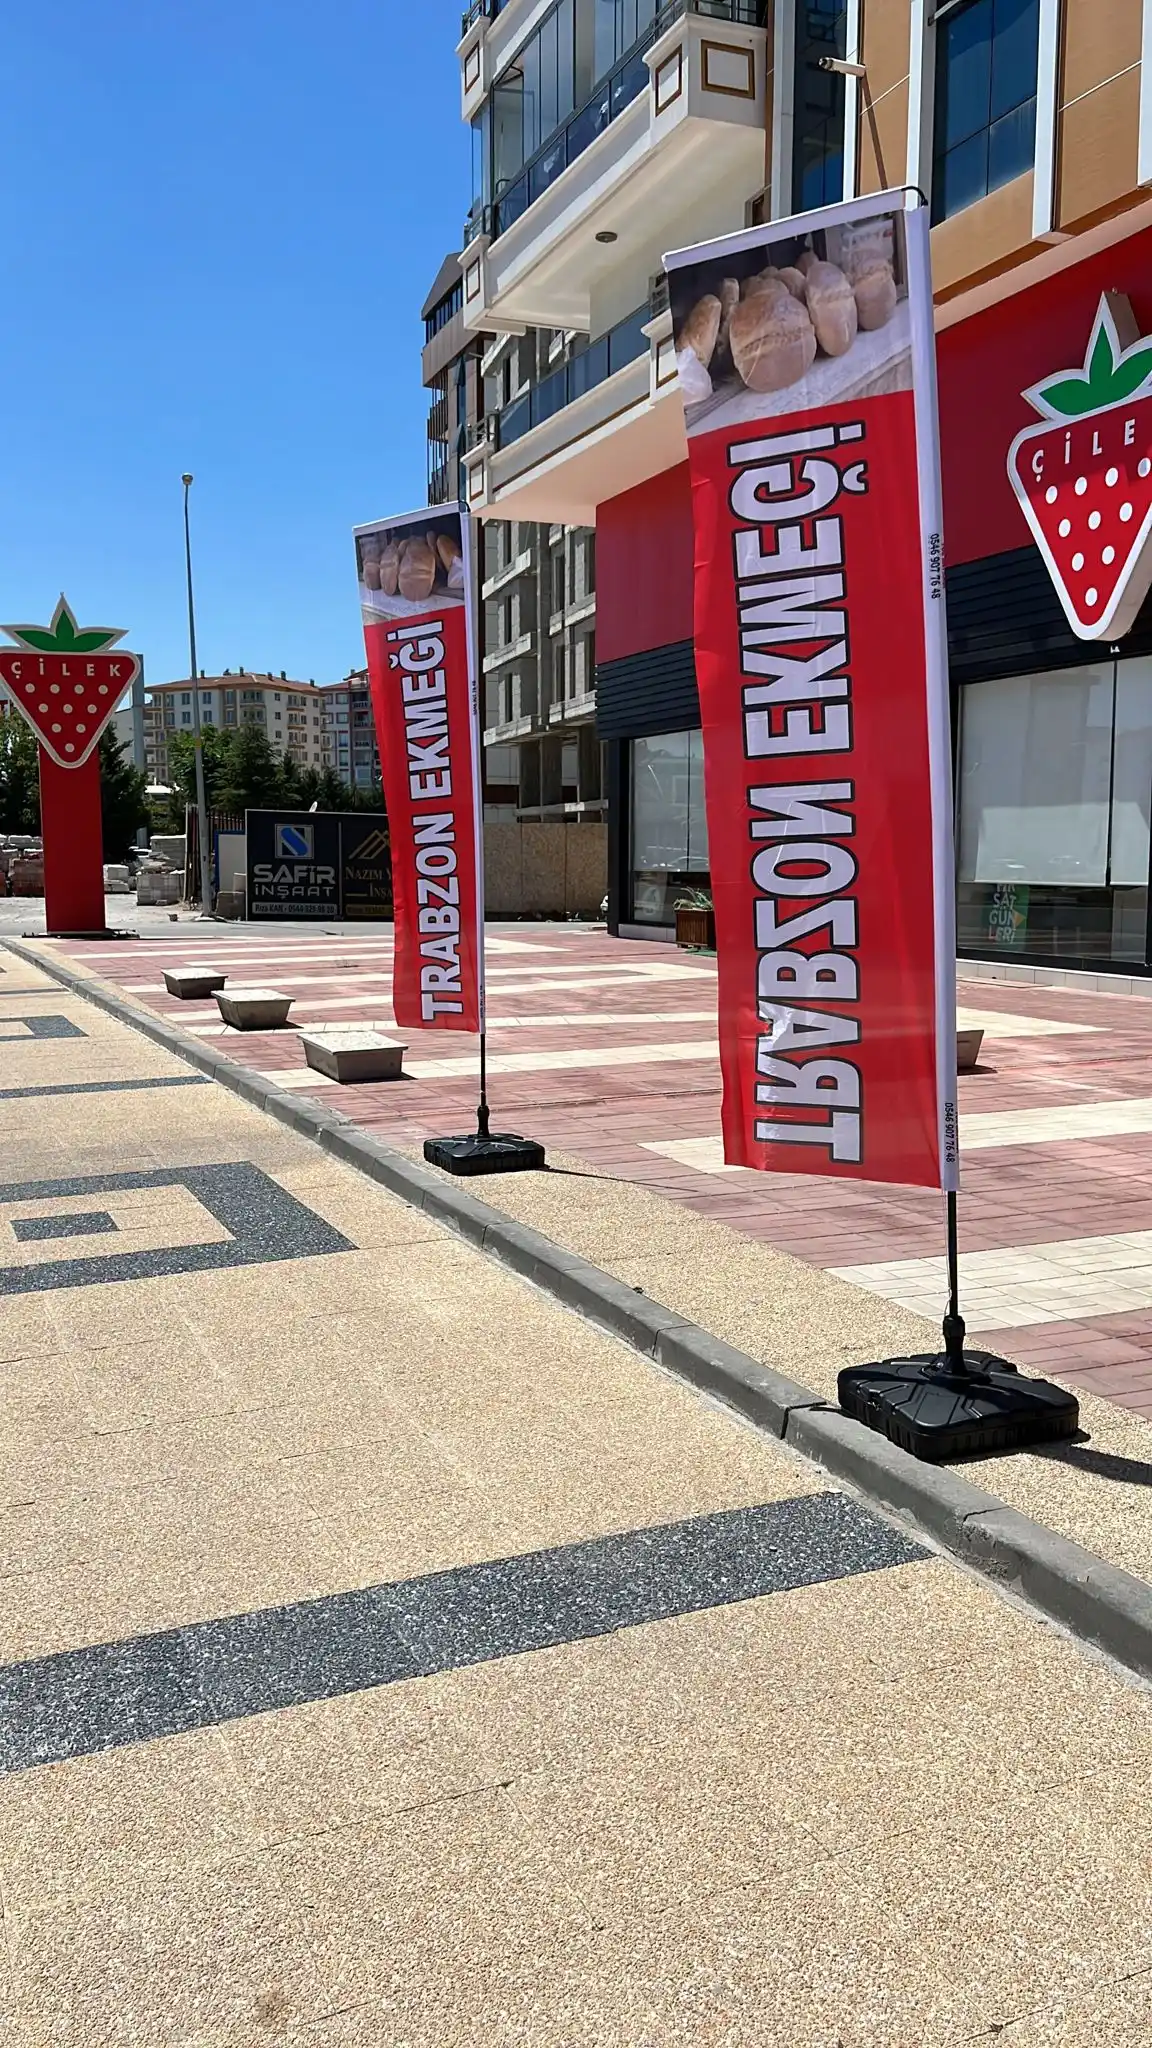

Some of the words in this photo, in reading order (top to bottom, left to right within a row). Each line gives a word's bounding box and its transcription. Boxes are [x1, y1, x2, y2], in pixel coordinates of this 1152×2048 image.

[930, 533, 940, 555] 0546
[930, 556, 941, 573] 907
[930, 574, 941, 586] 76
[931, 588, 941, 599] 48
[11, 658, 121, 679] ÇİLEK
[386, 620, 452, 801] EKMEĞİ
[411, 811, 464, 1022] TRABZON
[945, 1102, 954, 1122] 0546
[945, 1124, 955, 1139] 907
[946, 1141, 955, 1151] 76
[946, 1152, 956, 1163] 48
